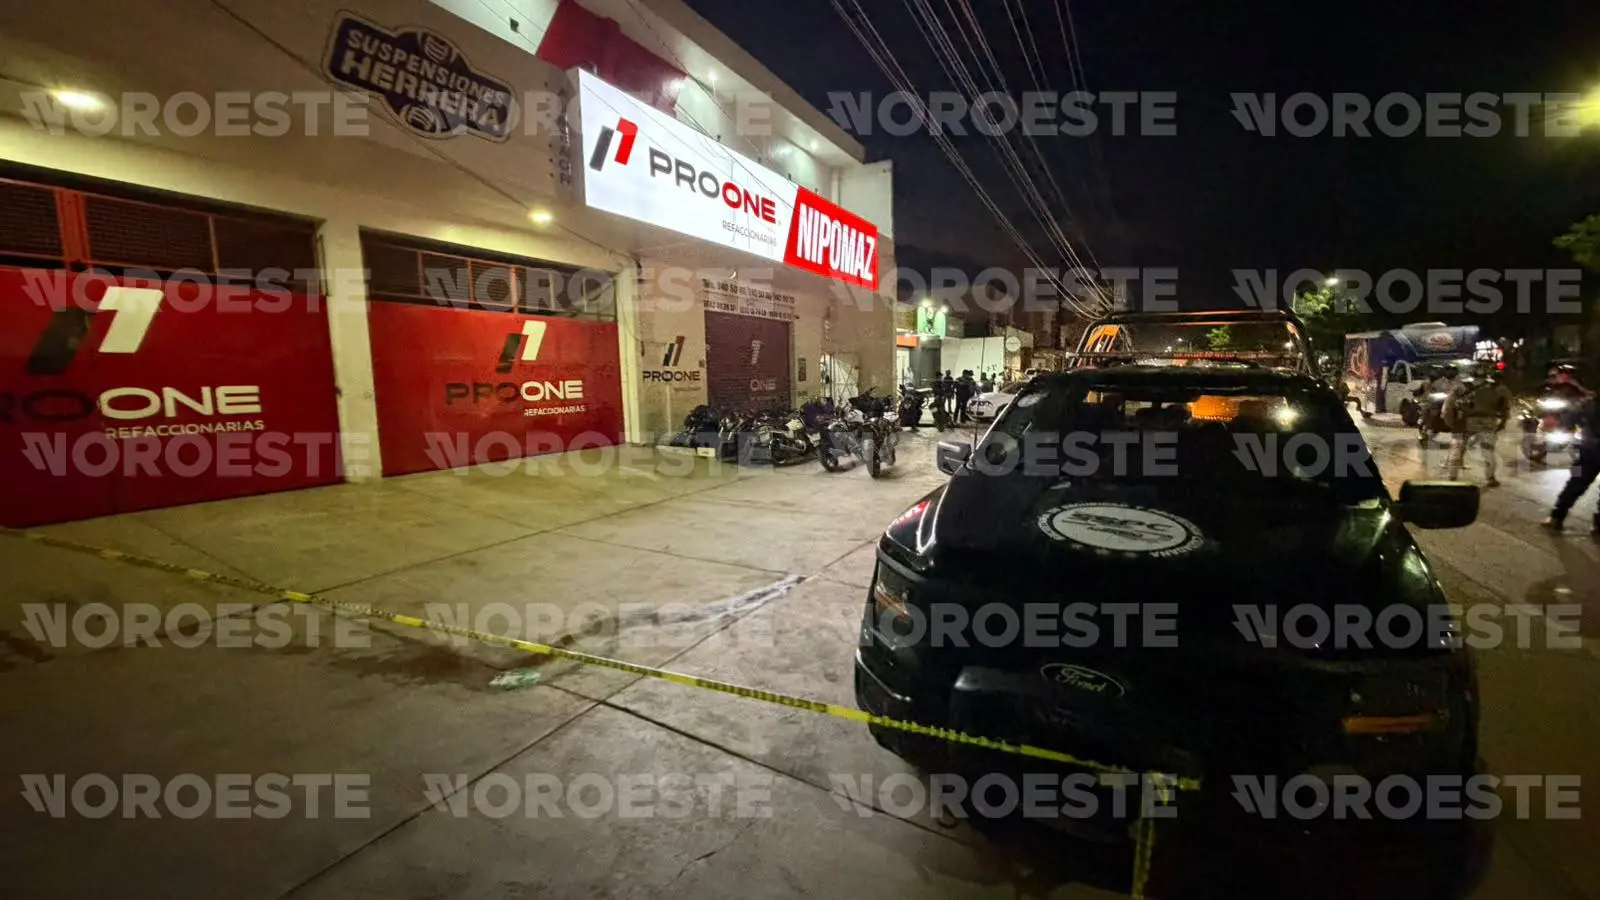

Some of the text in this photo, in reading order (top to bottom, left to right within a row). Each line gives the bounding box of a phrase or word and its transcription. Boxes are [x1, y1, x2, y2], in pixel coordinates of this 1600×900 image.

[340, 50, 502, 131] HERRERA
[347, 29, 503, 106] SUSPENSIONES
[649, 146, 776, 224] PROONE
[722, 220, 777, 246] REFACCIONARIAS
[797, 203, 876, 281] NIPOMAZ
[642, 369, 701, 383] PROONE
[105, 420, 266, 440] REFACCIONARIAS
[524, 404, 585, 417] REFACCIONARIAS
